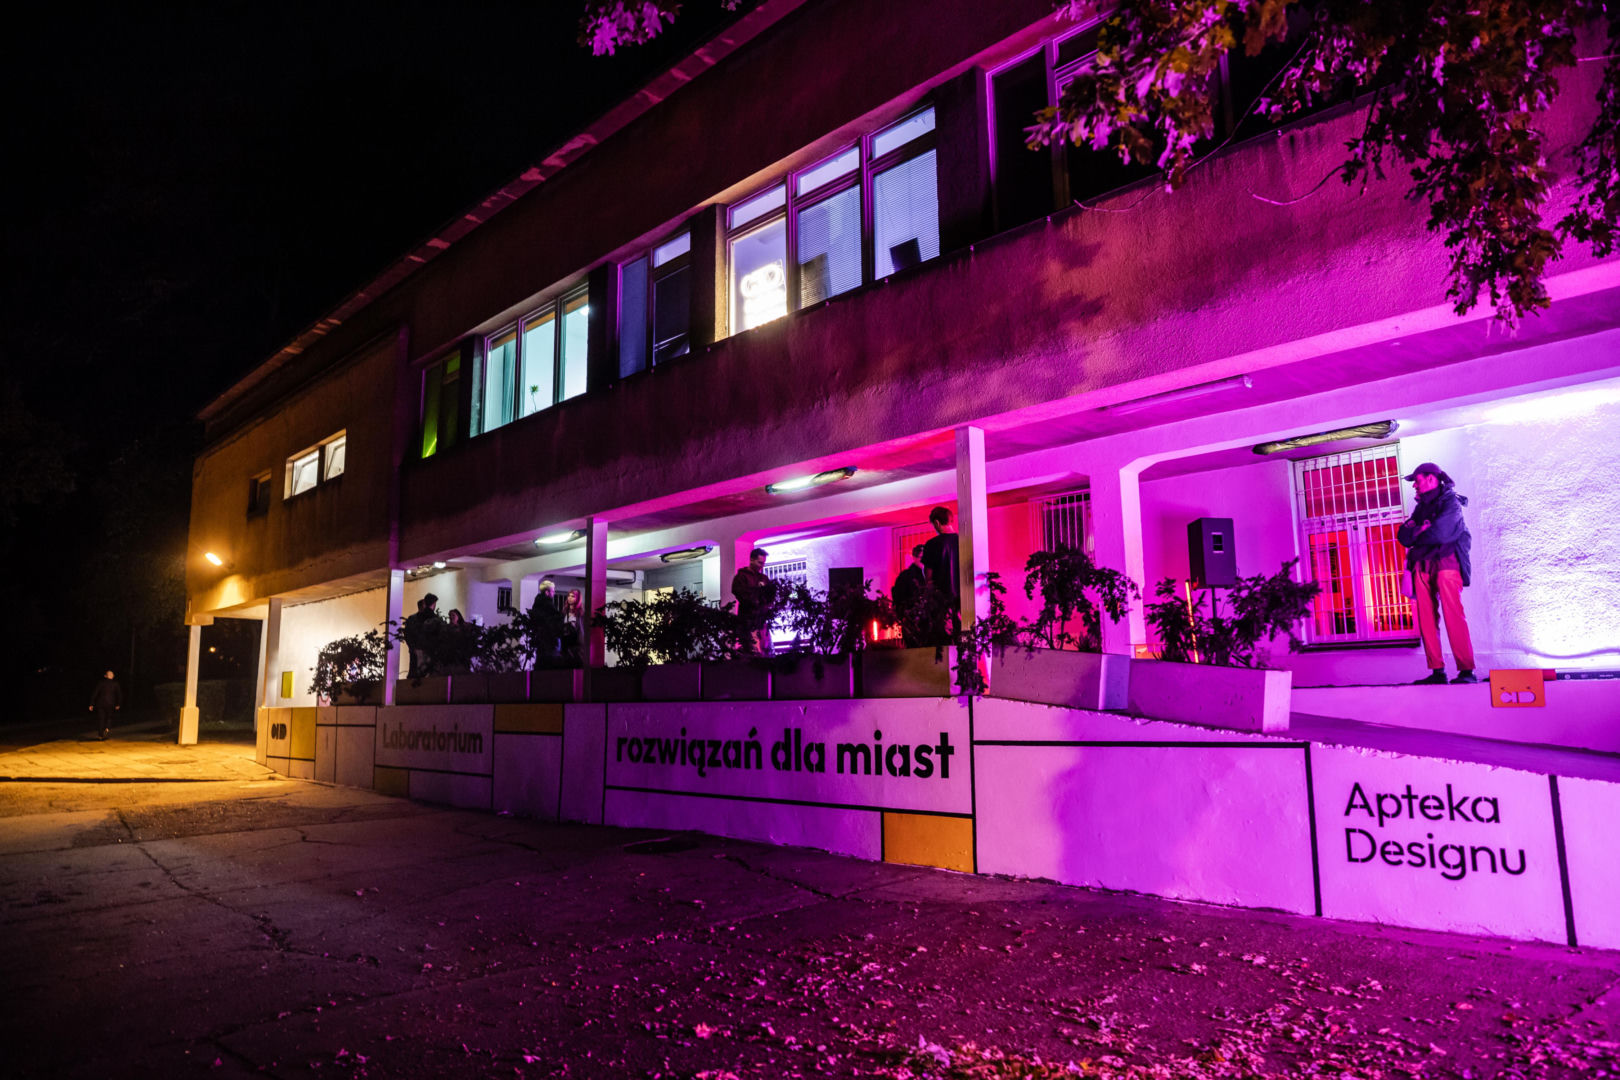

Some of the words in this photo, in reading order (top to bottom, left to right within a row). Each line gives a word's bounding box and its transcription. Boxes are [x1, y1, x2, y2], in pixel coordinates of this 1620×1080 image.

[382, 722, 483, 754] Laboratorium
[616, 727, 763, 778] rozwiązań
[771, 728, 826, 773] dla
[836, 730, 955, 779] miast
[1344, 782, 1501, 827] Apteka
[1345, 827, 1527, 880] Designu
